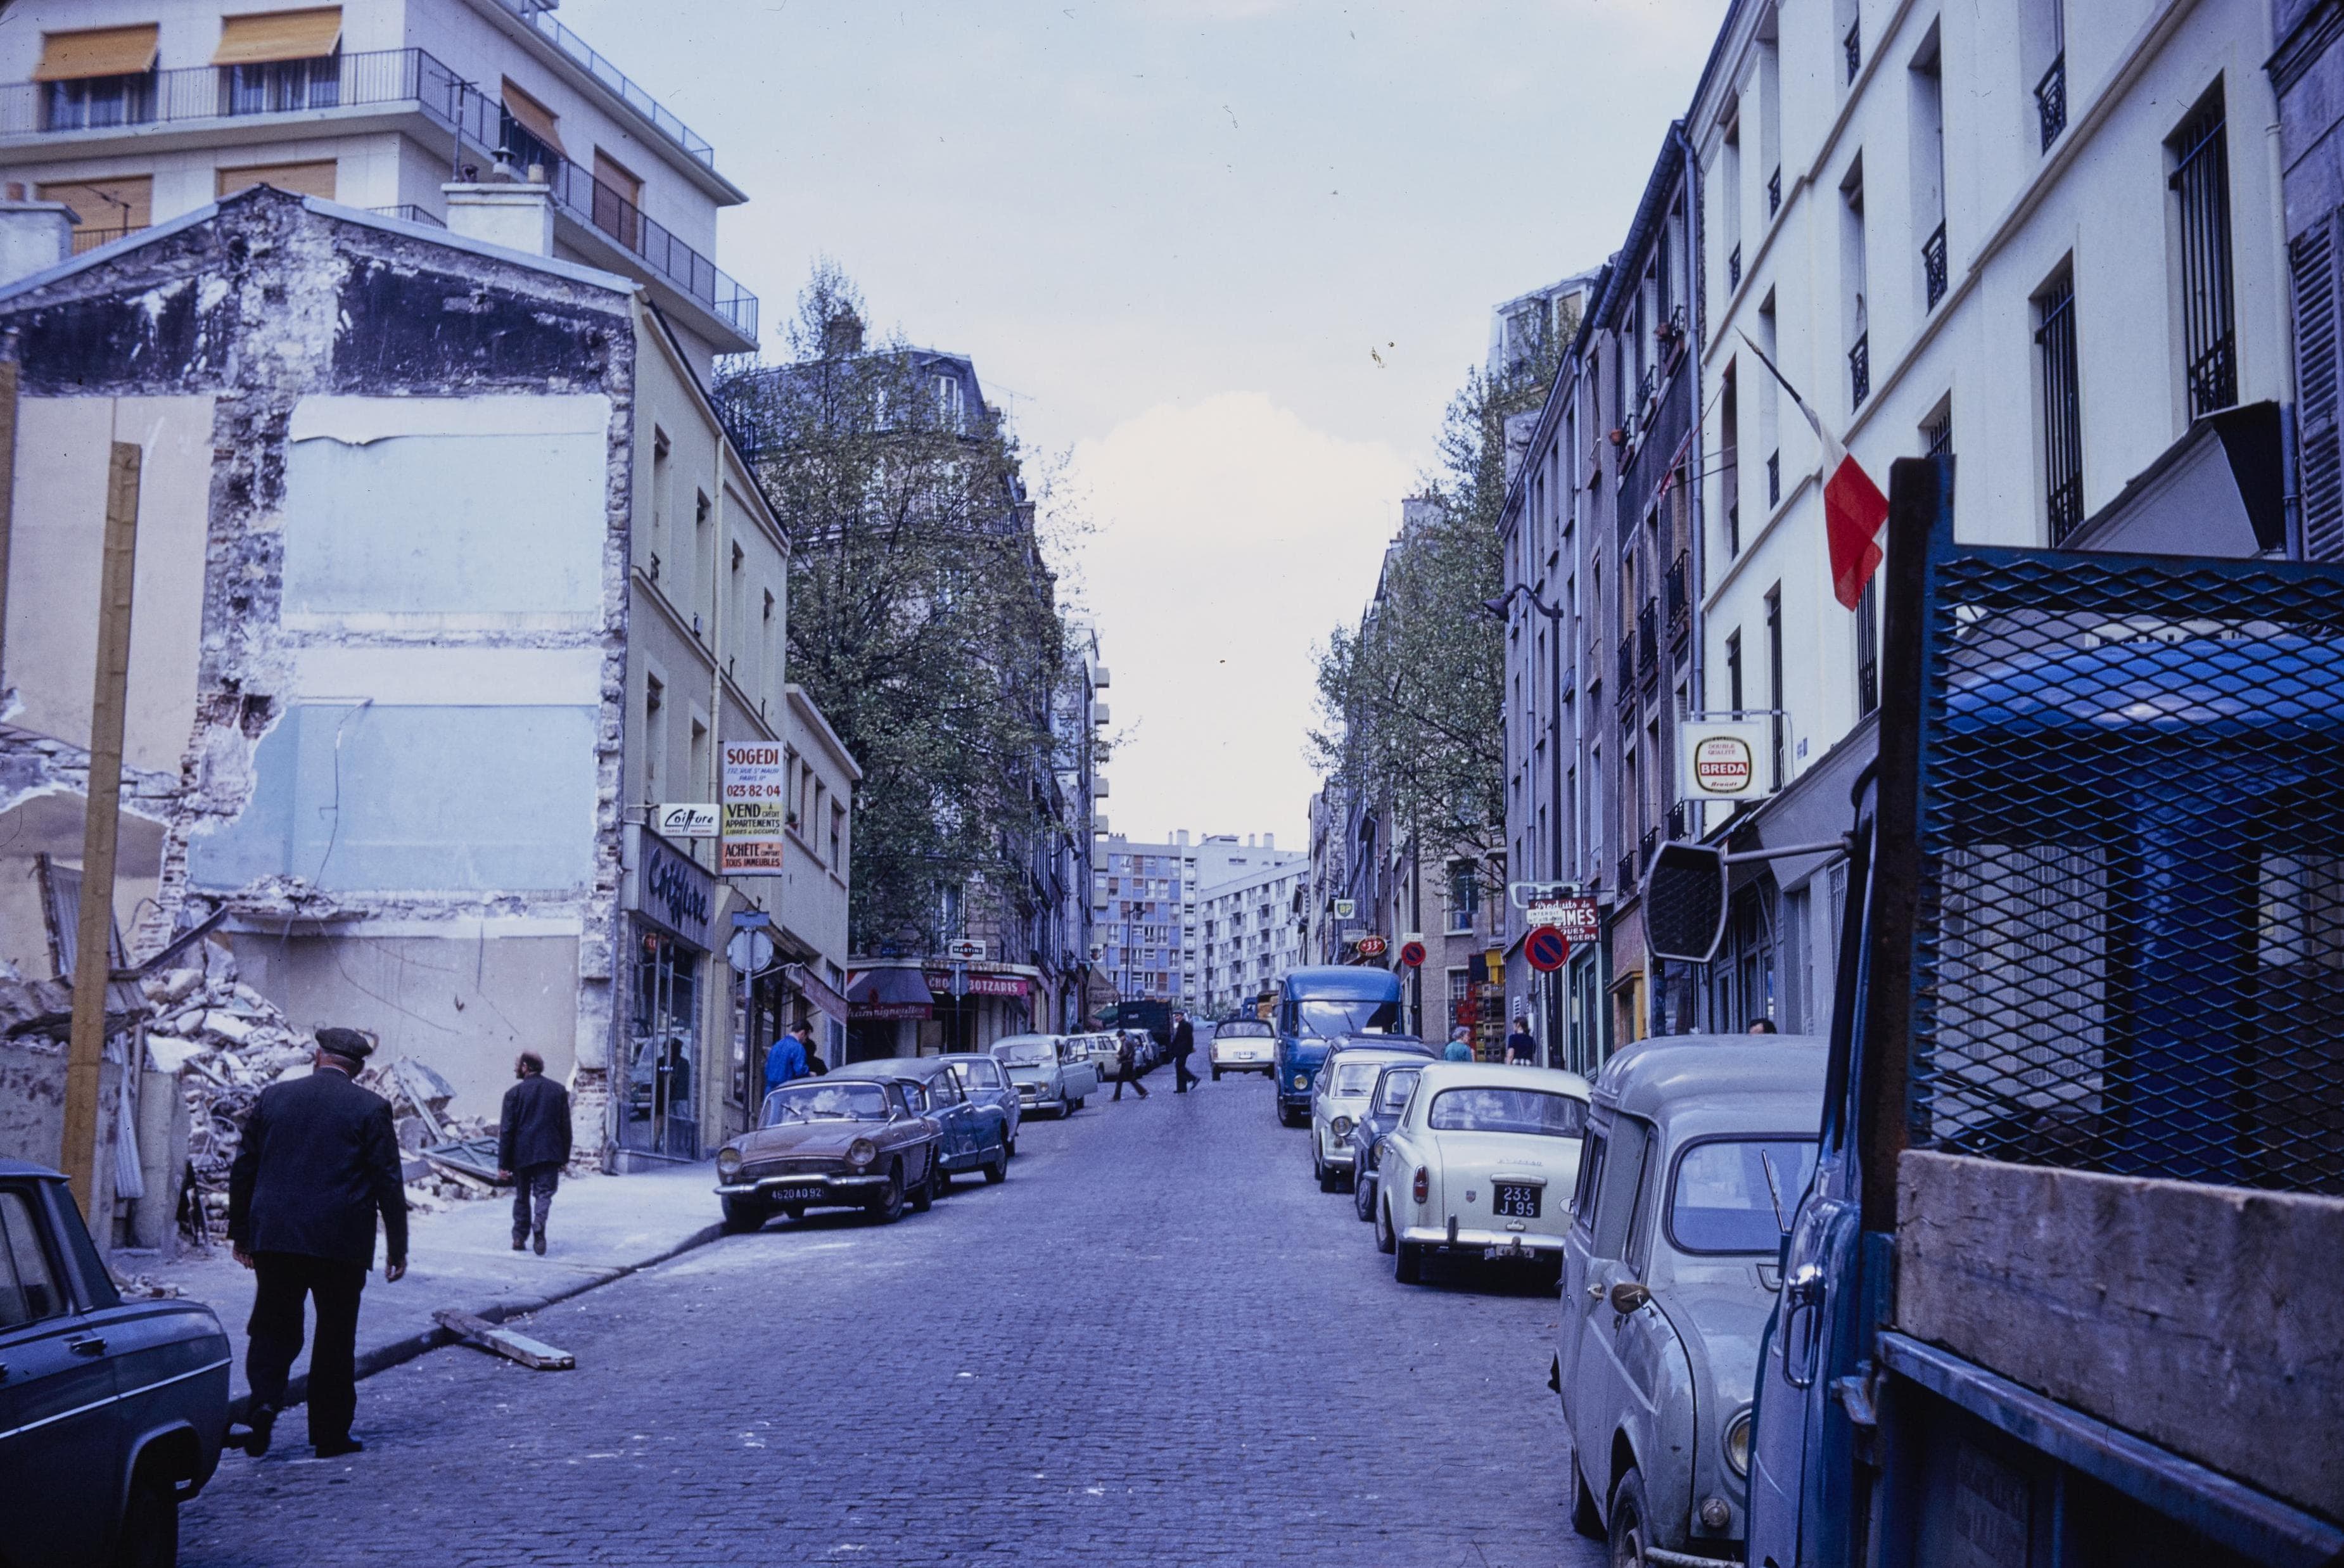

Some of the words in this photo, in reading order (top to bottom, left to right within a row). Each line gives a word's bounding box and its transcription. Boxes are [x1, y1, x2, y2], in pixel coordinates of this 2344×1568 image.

[727, 748, 779, 765] SOGEDI
[1700, 763, 1747, 774] BREDA
[727, 803, 761, 818] VEND
[665, 808, 714, 832] Coiffure
[725, 819, 780, 828] APPARTEMENTS
[725, 859, 742, 868] TOUS
[744, 858, 780, 867] IMMEUBLES
[648, 846, 710, 929] Coiffure
[1339, 905, 1351, 913] BP
[1581, 900, 1590, 908] de
[969, 979, 1018, 992] BOTZARIS
[810, 1188, 821, 1197] 92
[1504, 1187, 1531, 1201] 233
[1500, 1201, 1508, 1214] J
[1516, 1202, 1534, 1216] 95
